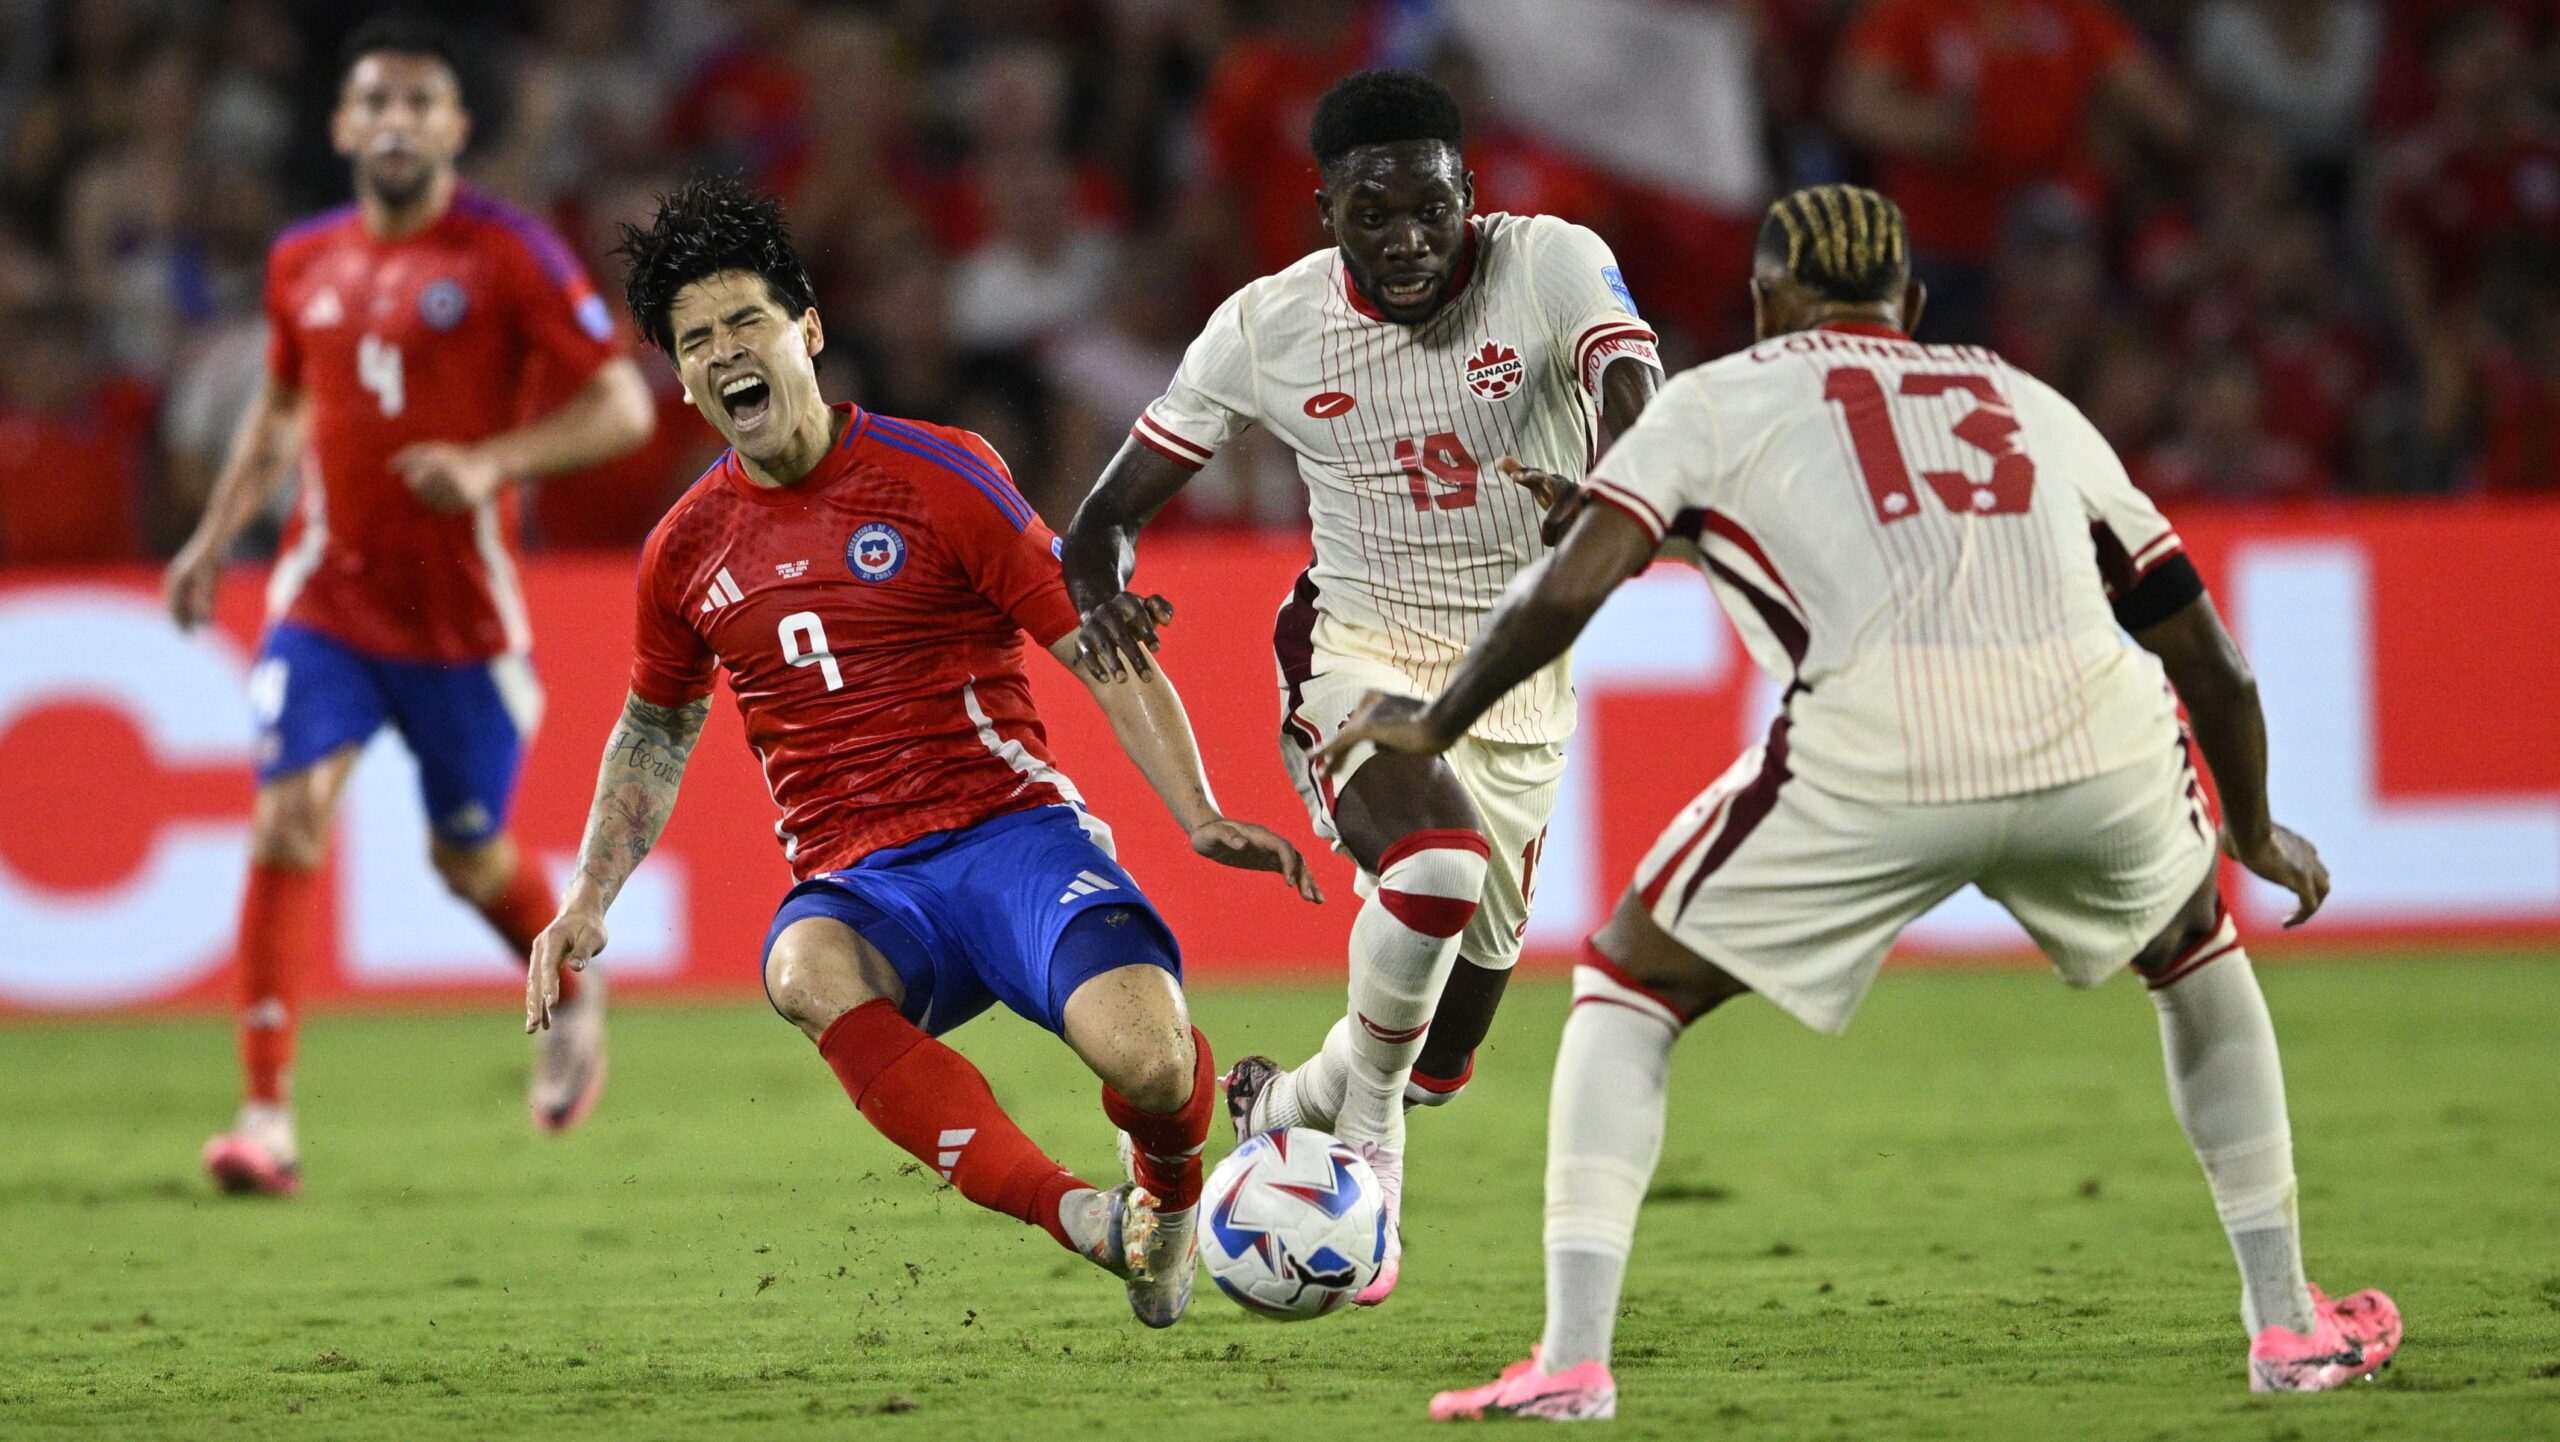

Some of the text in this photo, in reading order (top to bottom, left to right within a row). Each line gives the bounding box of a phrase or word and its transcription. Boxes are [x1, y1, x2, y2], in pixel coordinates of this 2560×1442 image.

[1466, 359, 1522, 383] CANADA
[1394, 432, 1478, 512] 19
[1824, 367, 2035, 524] 13
[778, 611, 844, 692] 9
